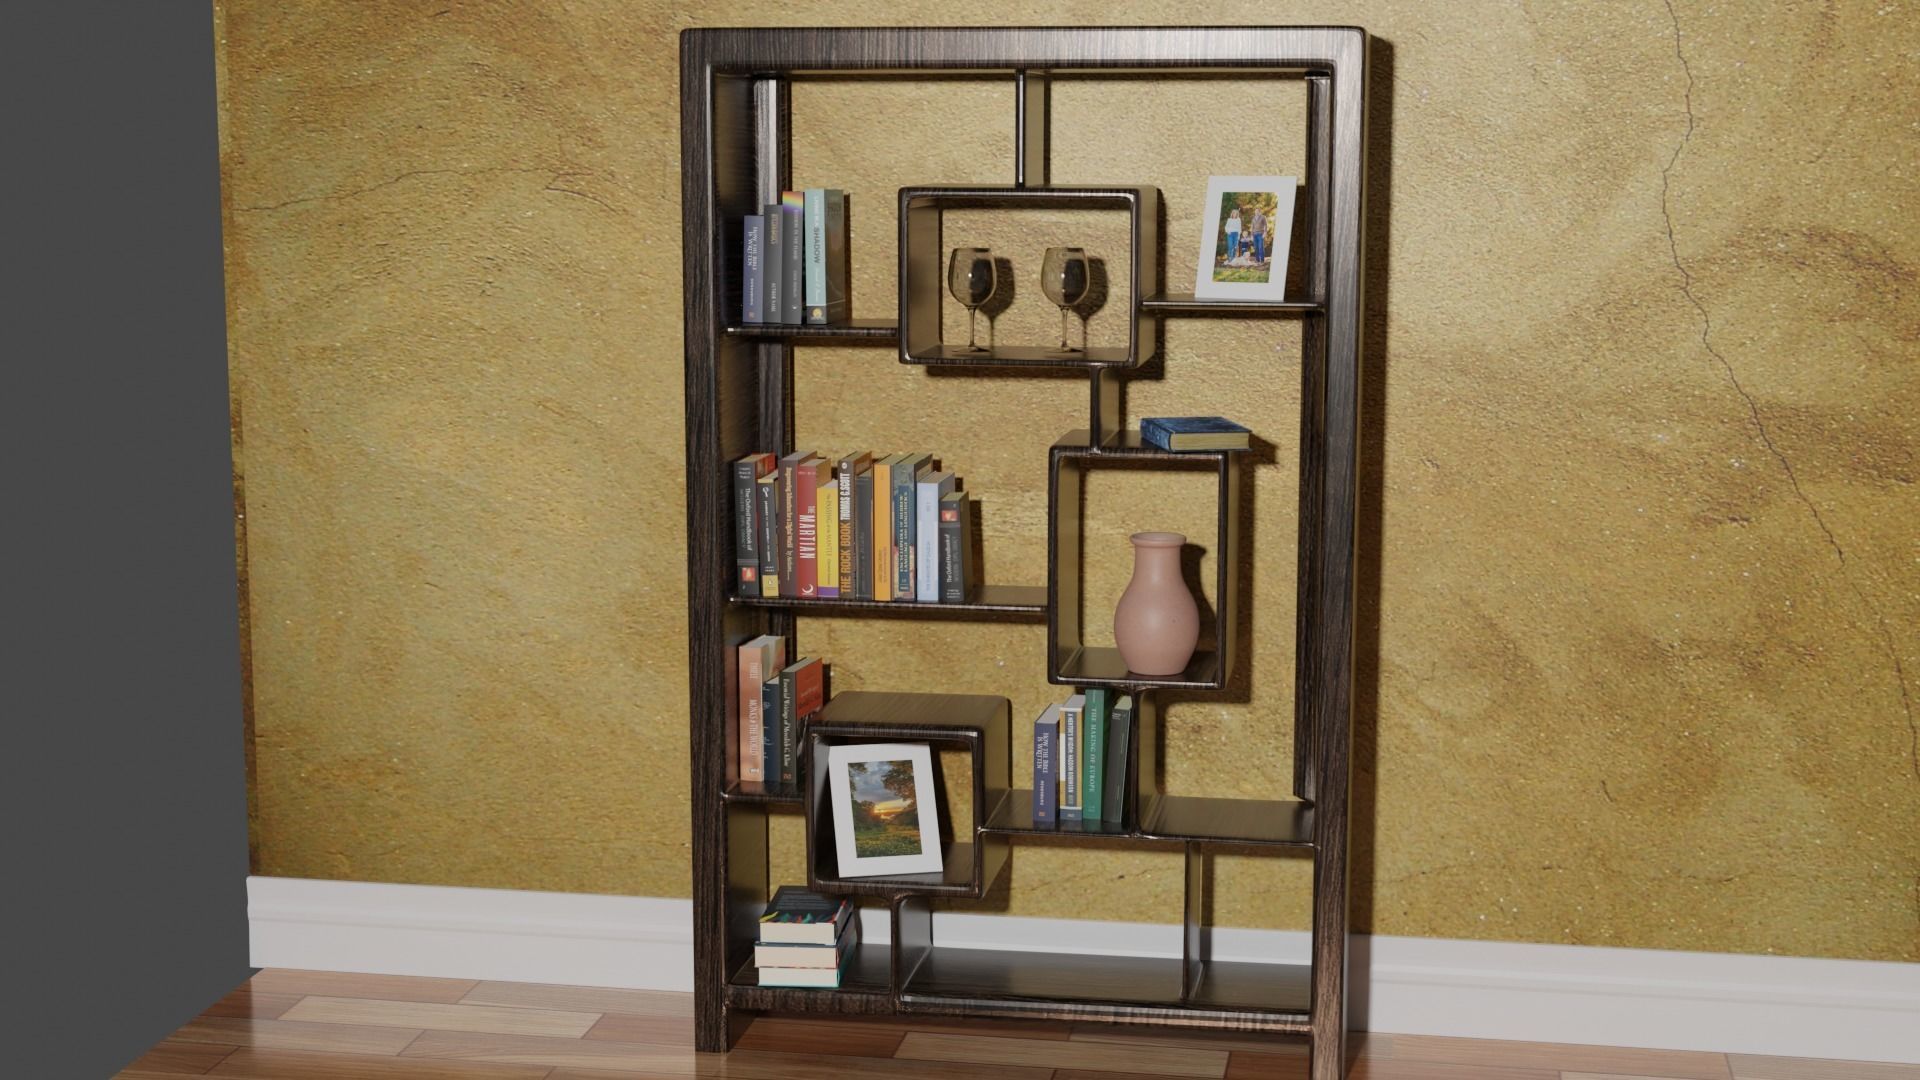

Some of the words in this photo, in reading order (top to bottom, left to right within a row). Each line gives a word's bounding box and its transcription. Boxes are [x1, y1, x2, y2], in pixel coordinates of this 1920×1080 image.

[839, 497, 851, 520] THOMAS
[799, 514, 816, 559] MARTIAN
[840, 522, 851, 547] BOOK
[840, 549, 851, 574] ROCK
[840, 576, 851, 593] THE
[1035, 743, 1043, 769] WRITTEN
[1089, 753, 1096, 763] OF
[1088, 765, 1096, 792] EUROPE
